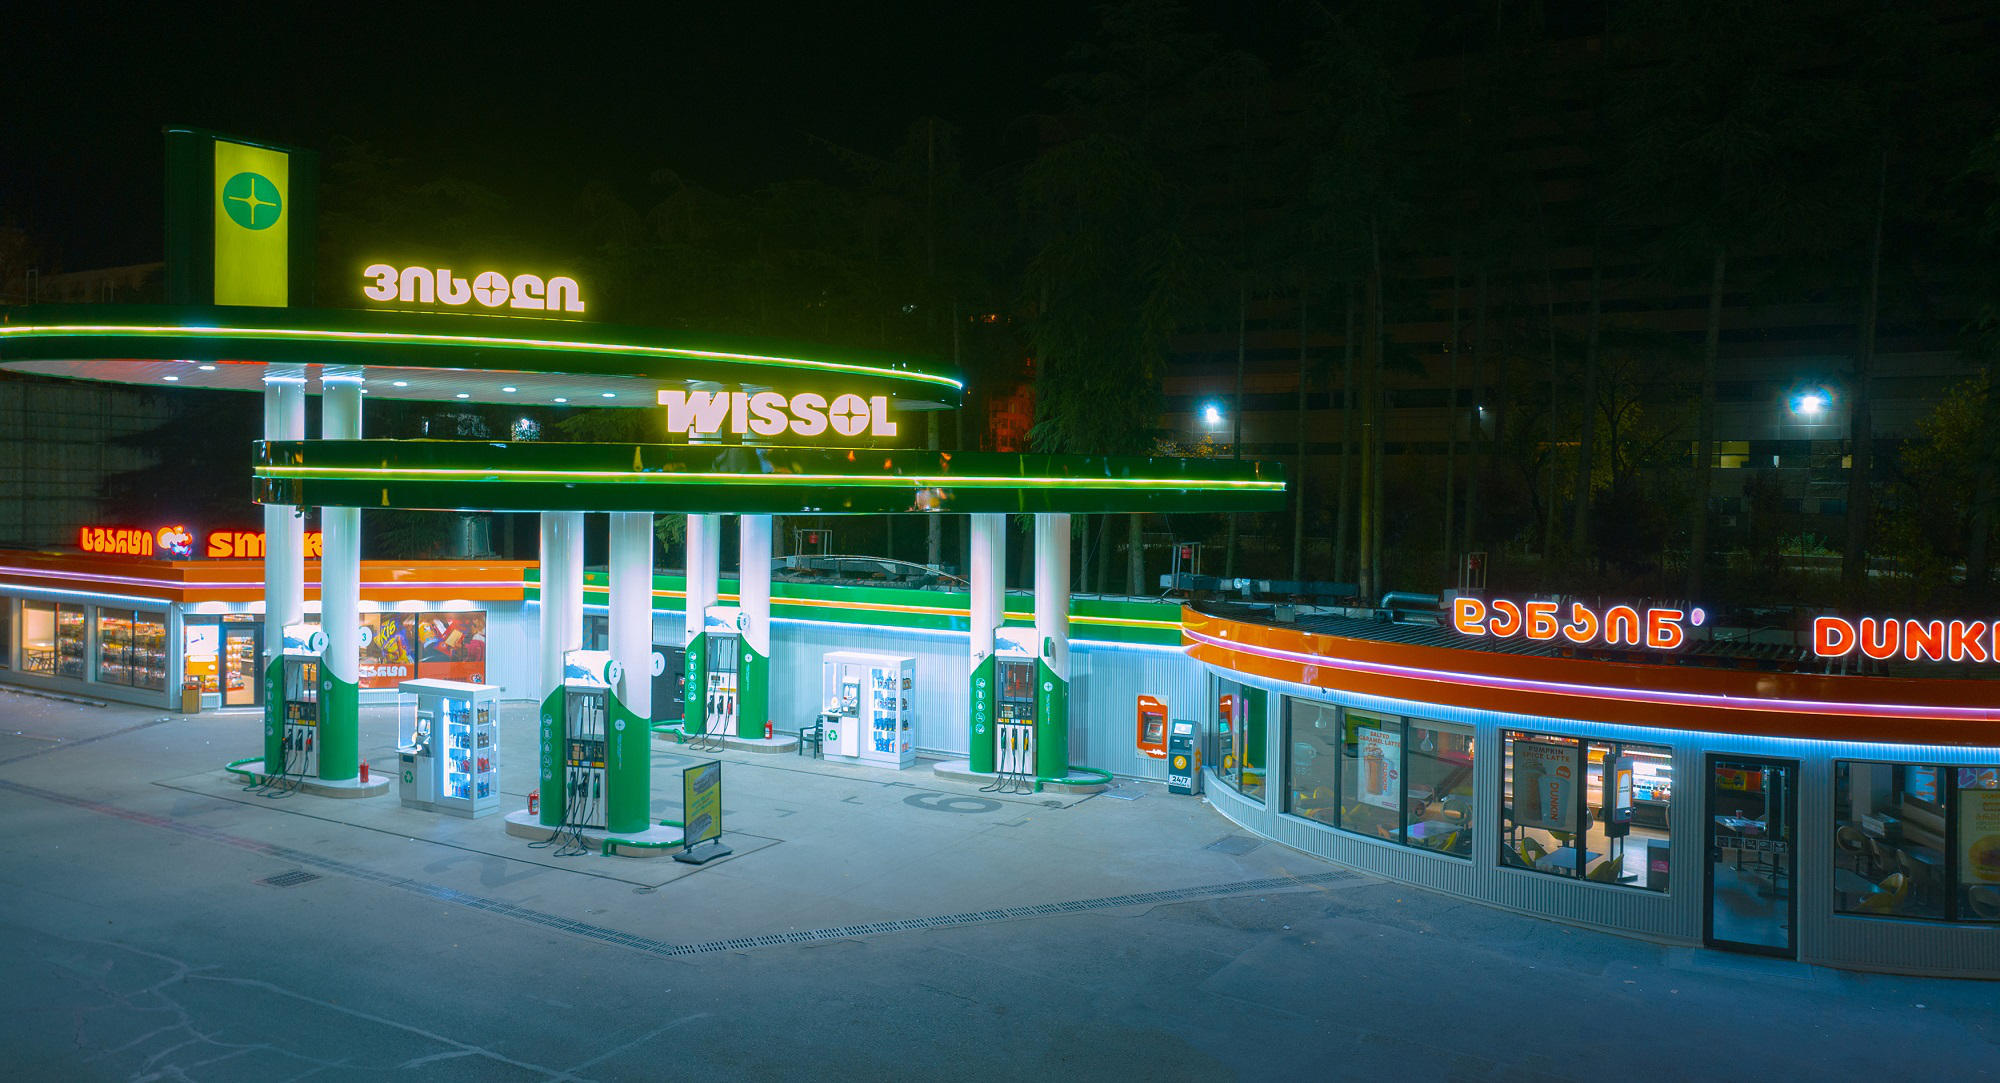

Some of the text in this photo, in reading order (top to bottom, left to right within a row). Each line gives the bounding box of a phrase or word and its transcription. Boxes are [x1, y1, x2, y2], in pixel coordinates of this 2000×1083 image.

[657, 390, 898, 437] WISSOL
[318, 637, 323, 646] 4
[362, 633, 367, 642] 3
[655, 659, 659, 669] 1
[613, 667, 618, 678] 2
[1528, 745, 1564, 755] PUMPKIN
[1546, 753, 1569, 763] LATTE
[1172, 775, 1188, 784] 24/7
